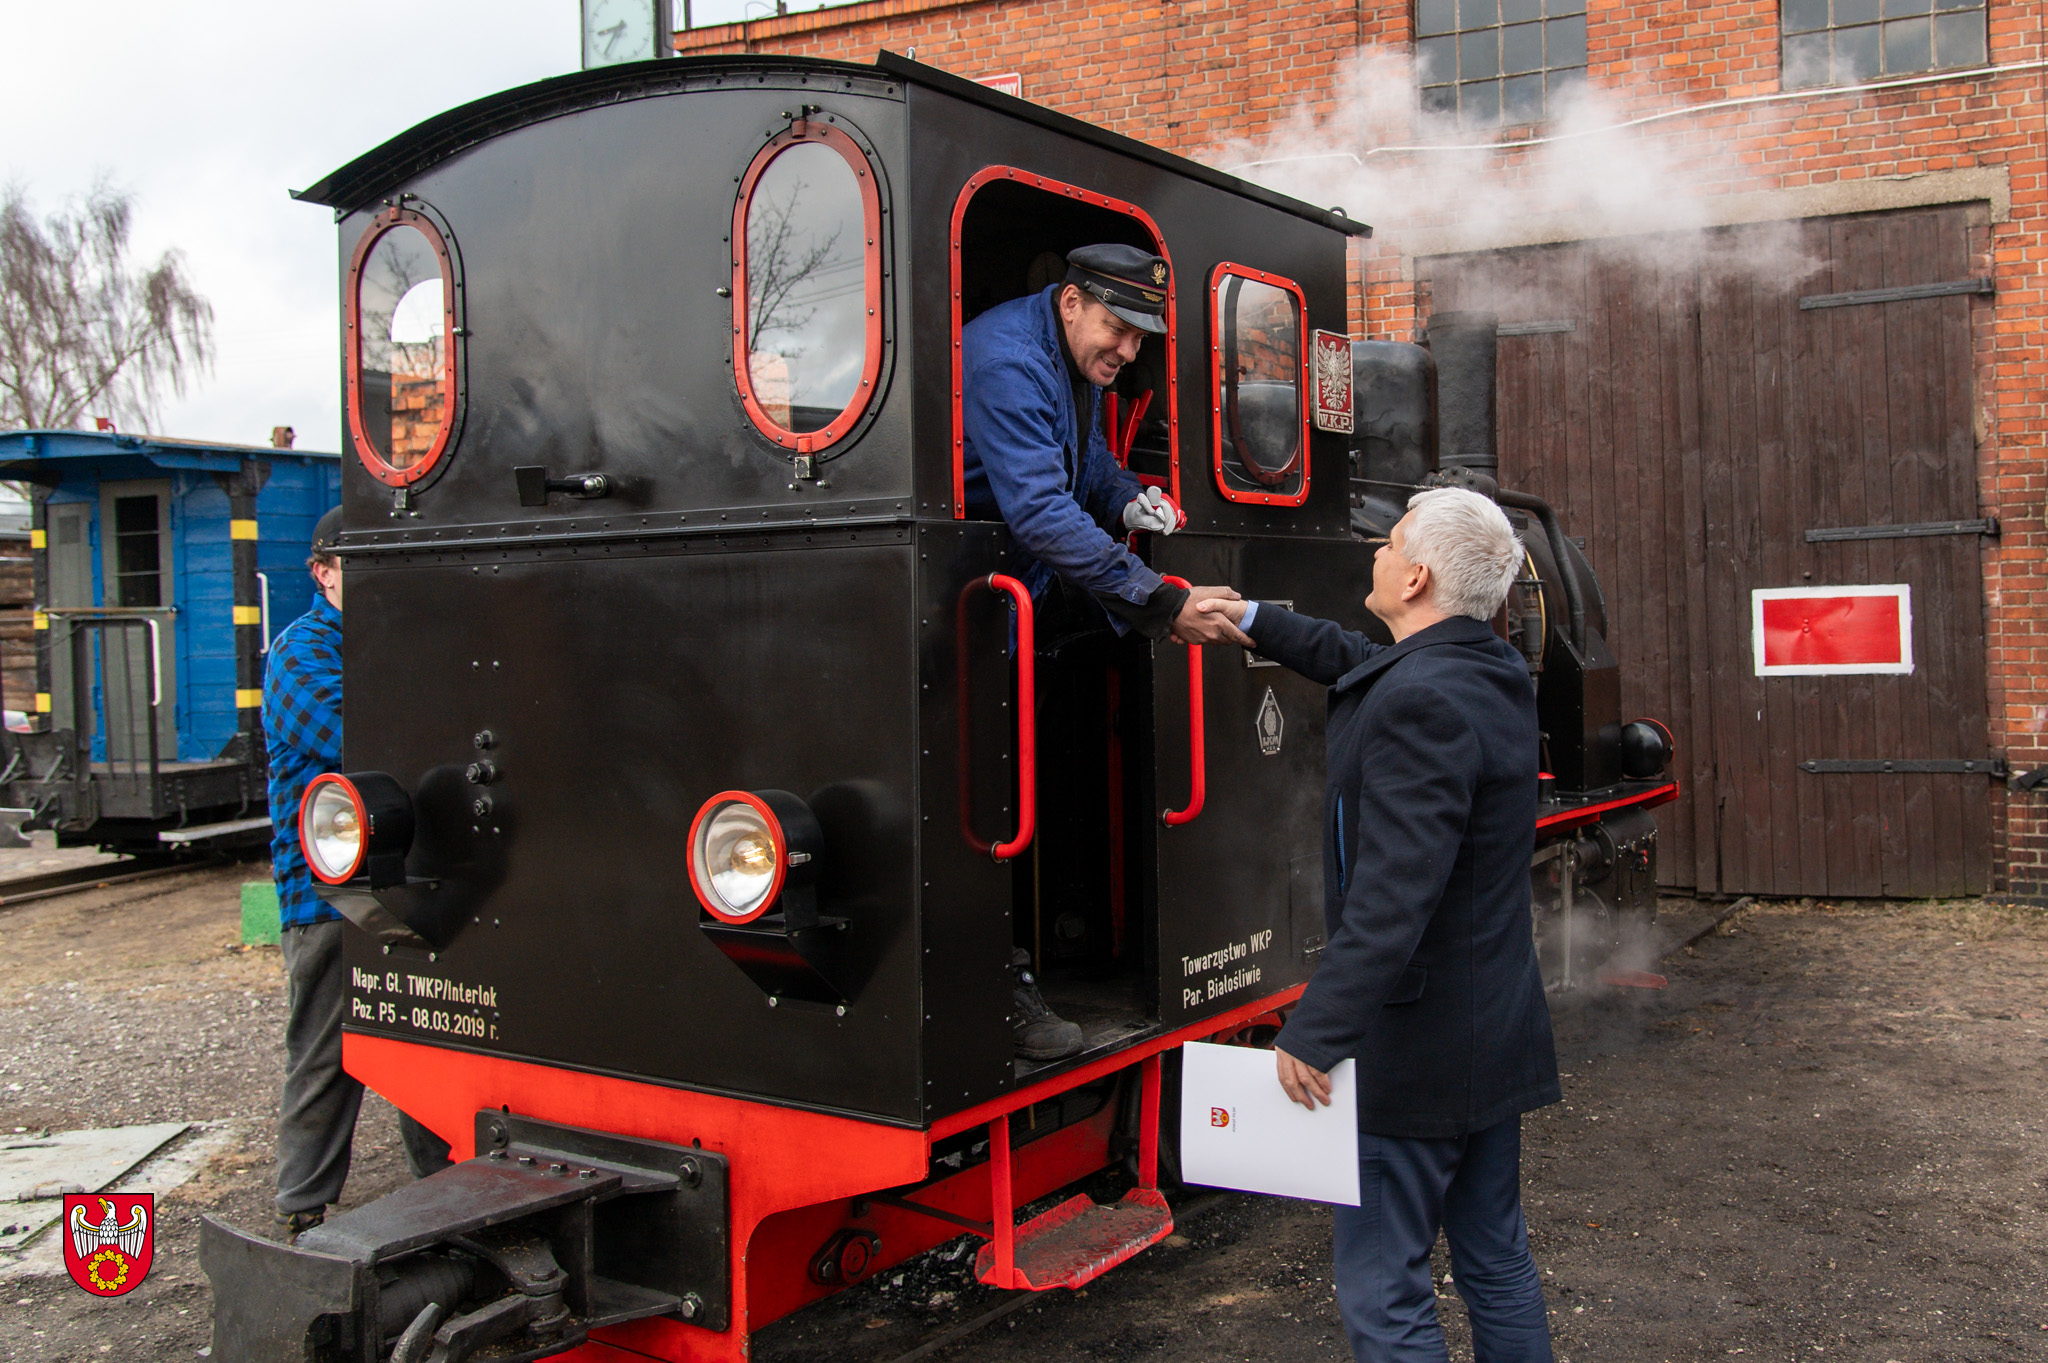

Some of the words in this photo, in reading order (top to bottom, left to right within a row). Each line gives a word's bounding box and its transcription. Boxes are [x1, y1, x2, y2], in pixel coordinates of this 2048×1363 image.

[1182, 942, 1247, 977] Towarzystwo
[1250, 929, 1272, 953] WKP
[352, 966, 382, 994] Napr.
[407, 975, 497, 1007] TWKP/Interlok
[1183, 988, 1204, 1009] Par.
[1208, 964, 1261, 1000] Białośliwie
[352, 997, 375, 1020] Poz.
[379, 1002, 396, 1023] P5
[412, 1007, 485, 1037] 08.03.2019
[490, 1024, 499, 1040] r.
